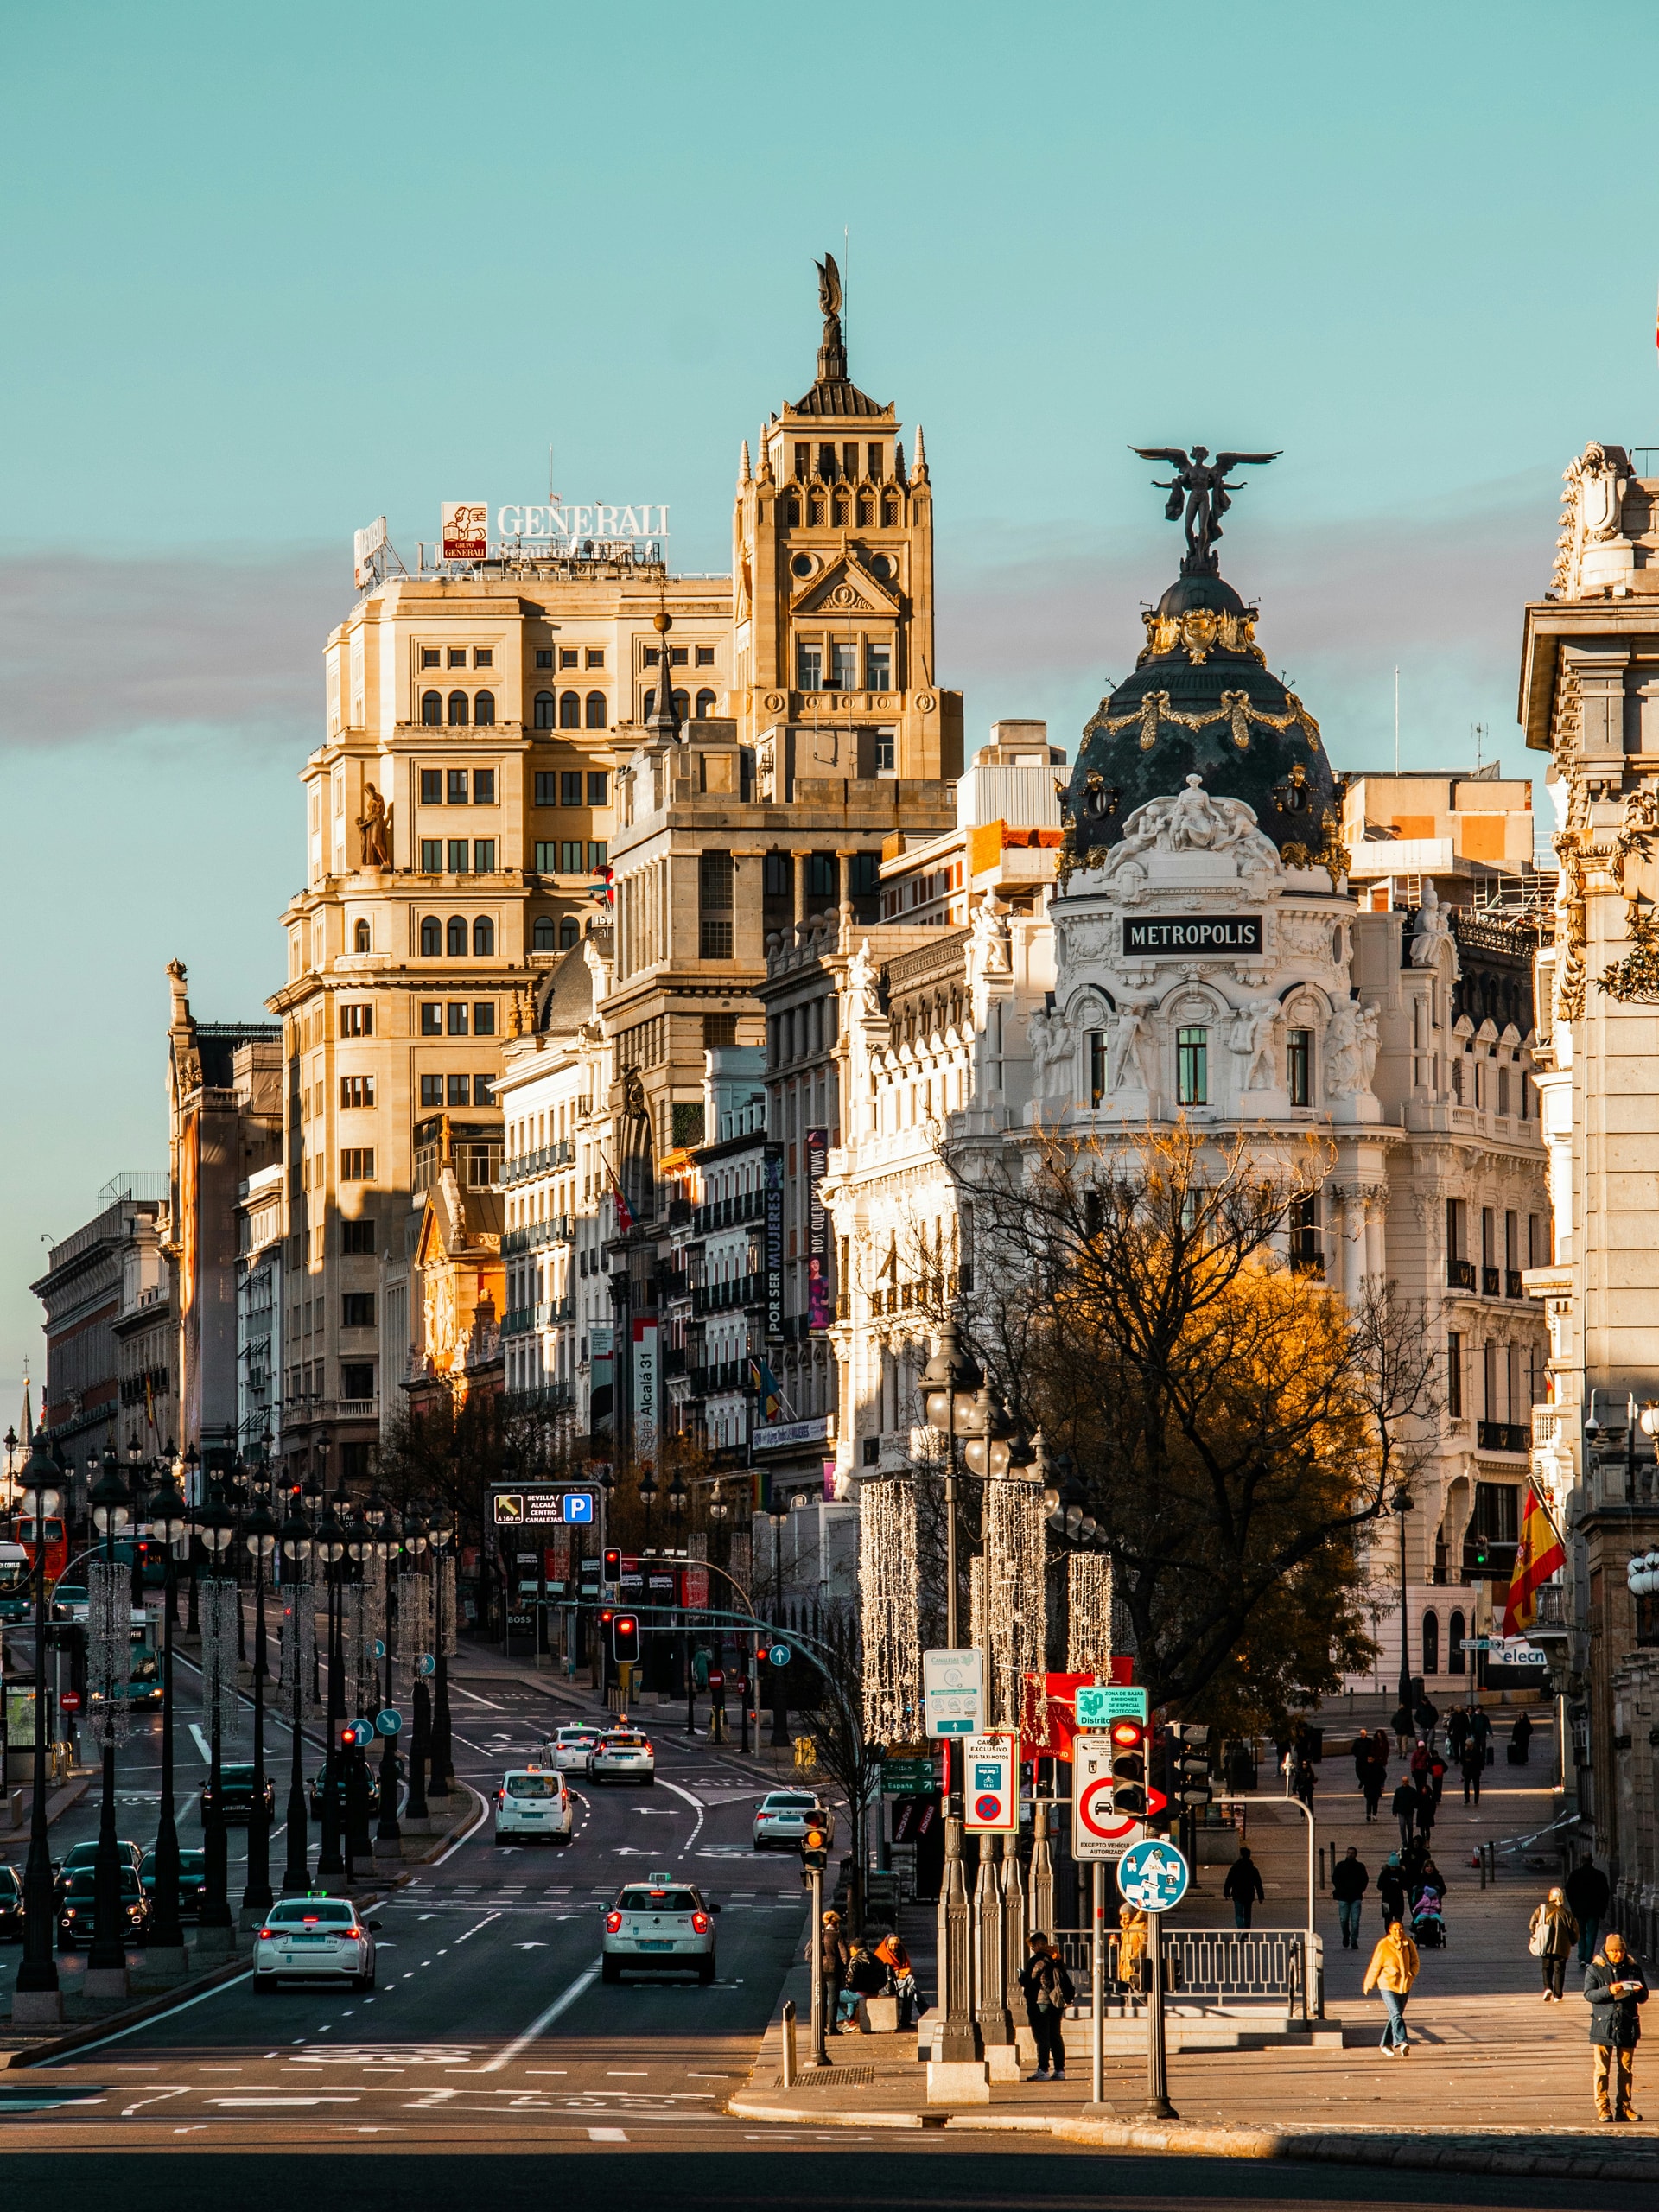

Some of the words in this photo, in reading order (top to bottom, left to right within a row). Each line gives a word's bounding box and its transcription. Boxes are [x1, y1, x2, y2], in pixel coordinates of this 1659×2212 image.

[497, 505, 671, 537] GENERALI
[444, 548, 485, 557] GENERALI
[1131, 925, 1255, 945] METROPOLIS
[810, 1149, 825, 1176] VIVAS
[767, 1192, 781, 1268] MUJERES
[810, 1234, 825, 1253] NOS
[768, 1272, 780, 1297] SER
[768, 1300, 780, 1332] POR
[640, 1353, 652, 1369] 31
[639, 1372, 652, 1416] Alcalá
[640, 1420, 652, 1448] Sala
[1081, 1716, 1111, 1725] Distrito
[1043, 1749, 1069, 1758] MADRID
